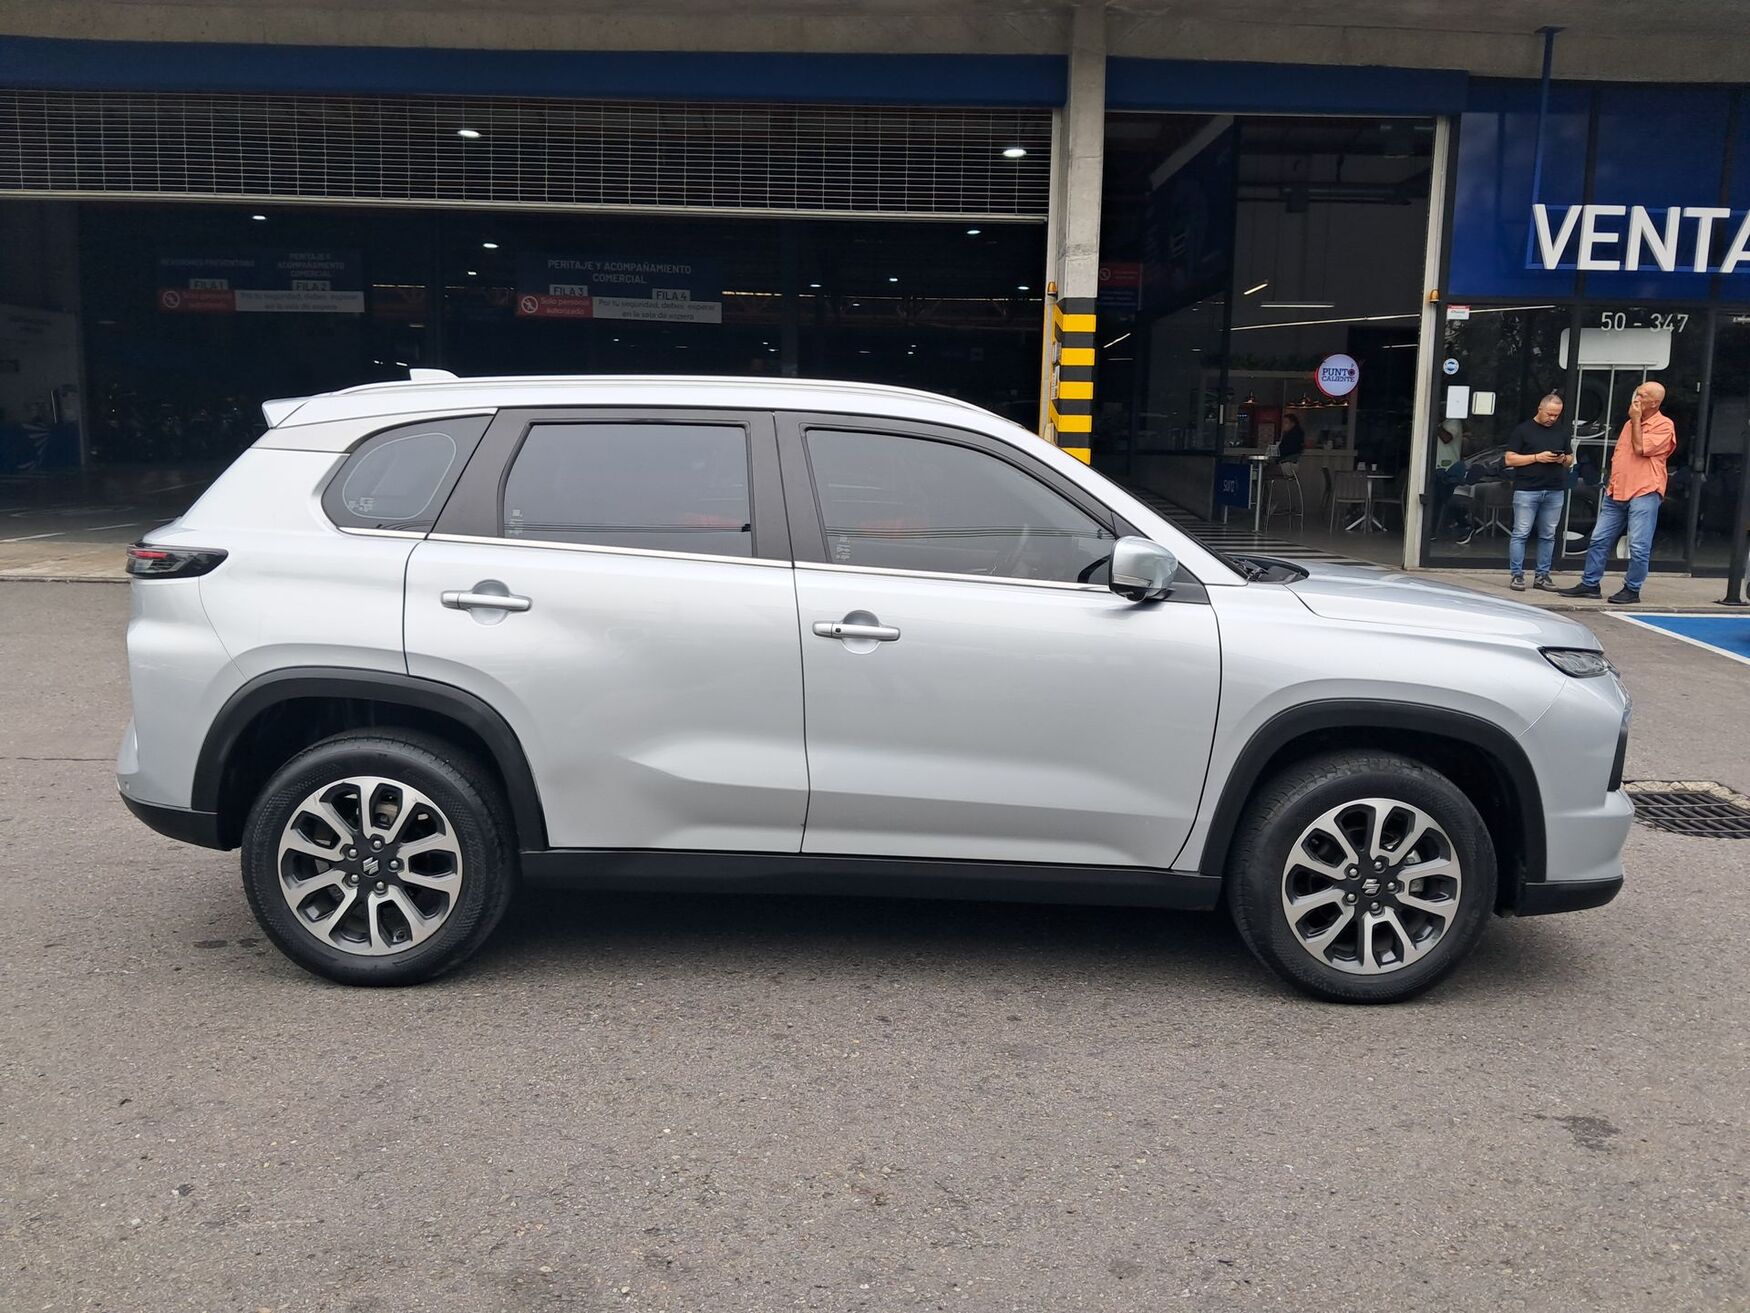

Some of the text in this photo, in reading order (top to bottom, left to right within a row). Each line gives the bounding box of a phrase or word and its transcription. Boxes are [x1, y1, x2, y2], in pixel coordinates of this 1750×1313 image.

[547, 259, 692, 275] PERITAJE Y ACOMPAÑAMIENTO
[592, 273, 647, 284] COMERCIAL
[194, 280, 217, 289] FILA
[296, 281, 319, 290] FILA
[553, 286, 584, 297] FILA 3
[656, 290, 687, 301] FILA 4
[1601, 312, 1626, 331] 50
[1650, 313, 1689, 333] 347
[1322, 367, 1355, 376] PUNTO
